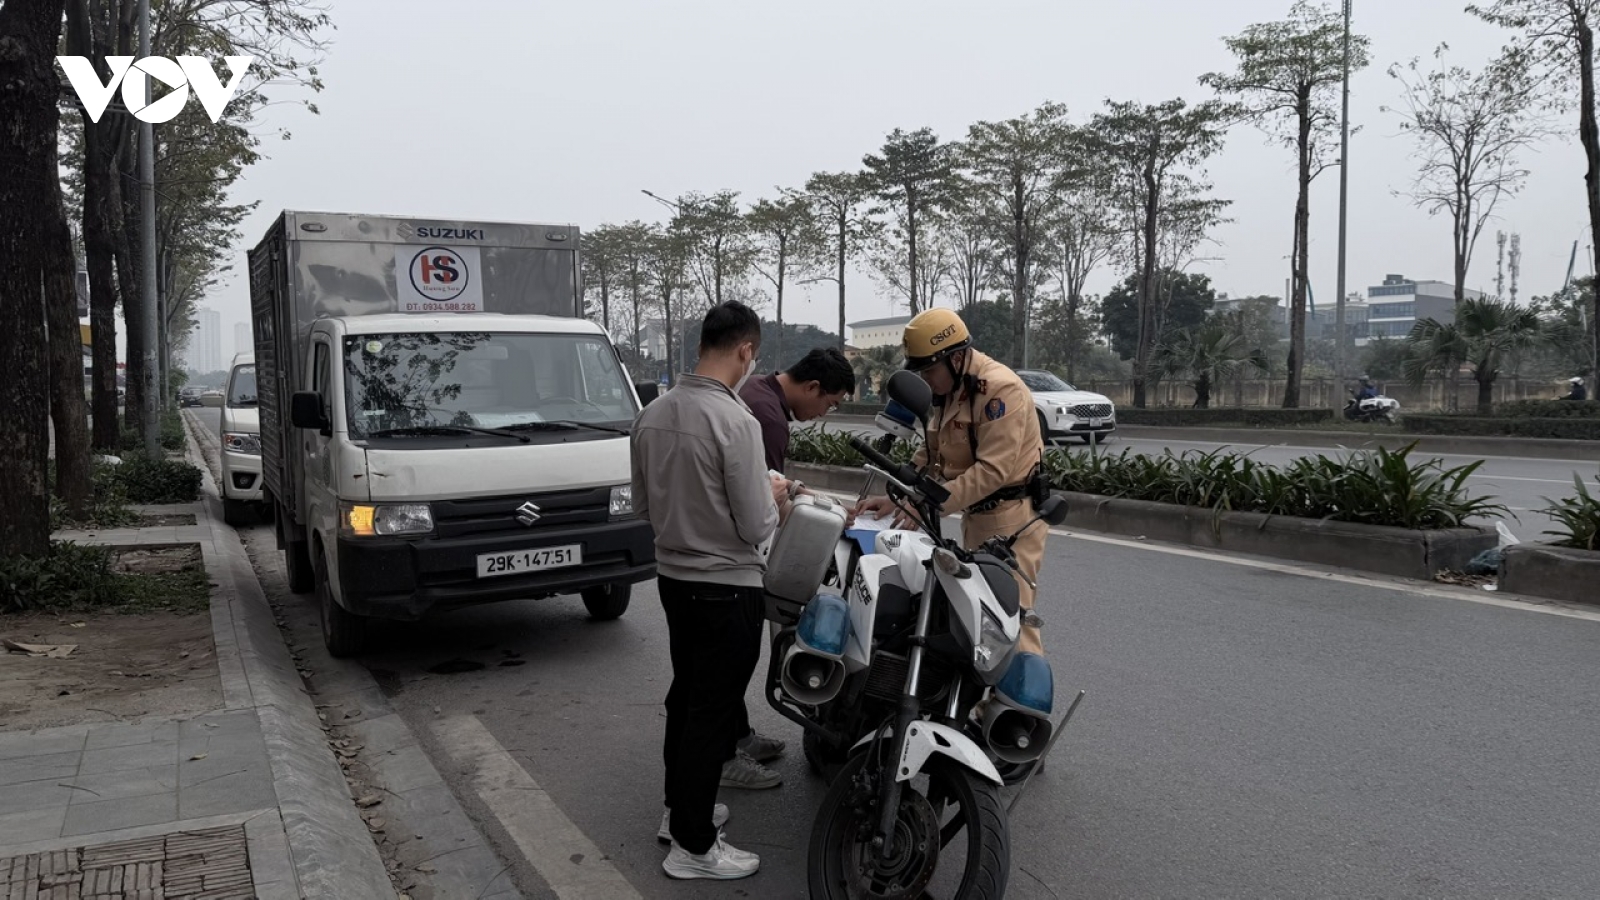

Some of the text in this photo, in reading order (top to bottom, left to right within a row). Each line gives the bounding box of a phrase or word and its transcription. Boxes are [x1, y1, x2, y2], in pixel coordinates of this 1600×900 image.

[417, 227, 484, 240] SUZUKI
[420, 254, 460, 285] HS
[406, 303, 476, 311] ĐT: 0934.588.282
[929, 324, 957, 346] CSGT
[486, 549, 572, 573] 29K-147.51
[856, 566, 872, 606] POLICE
